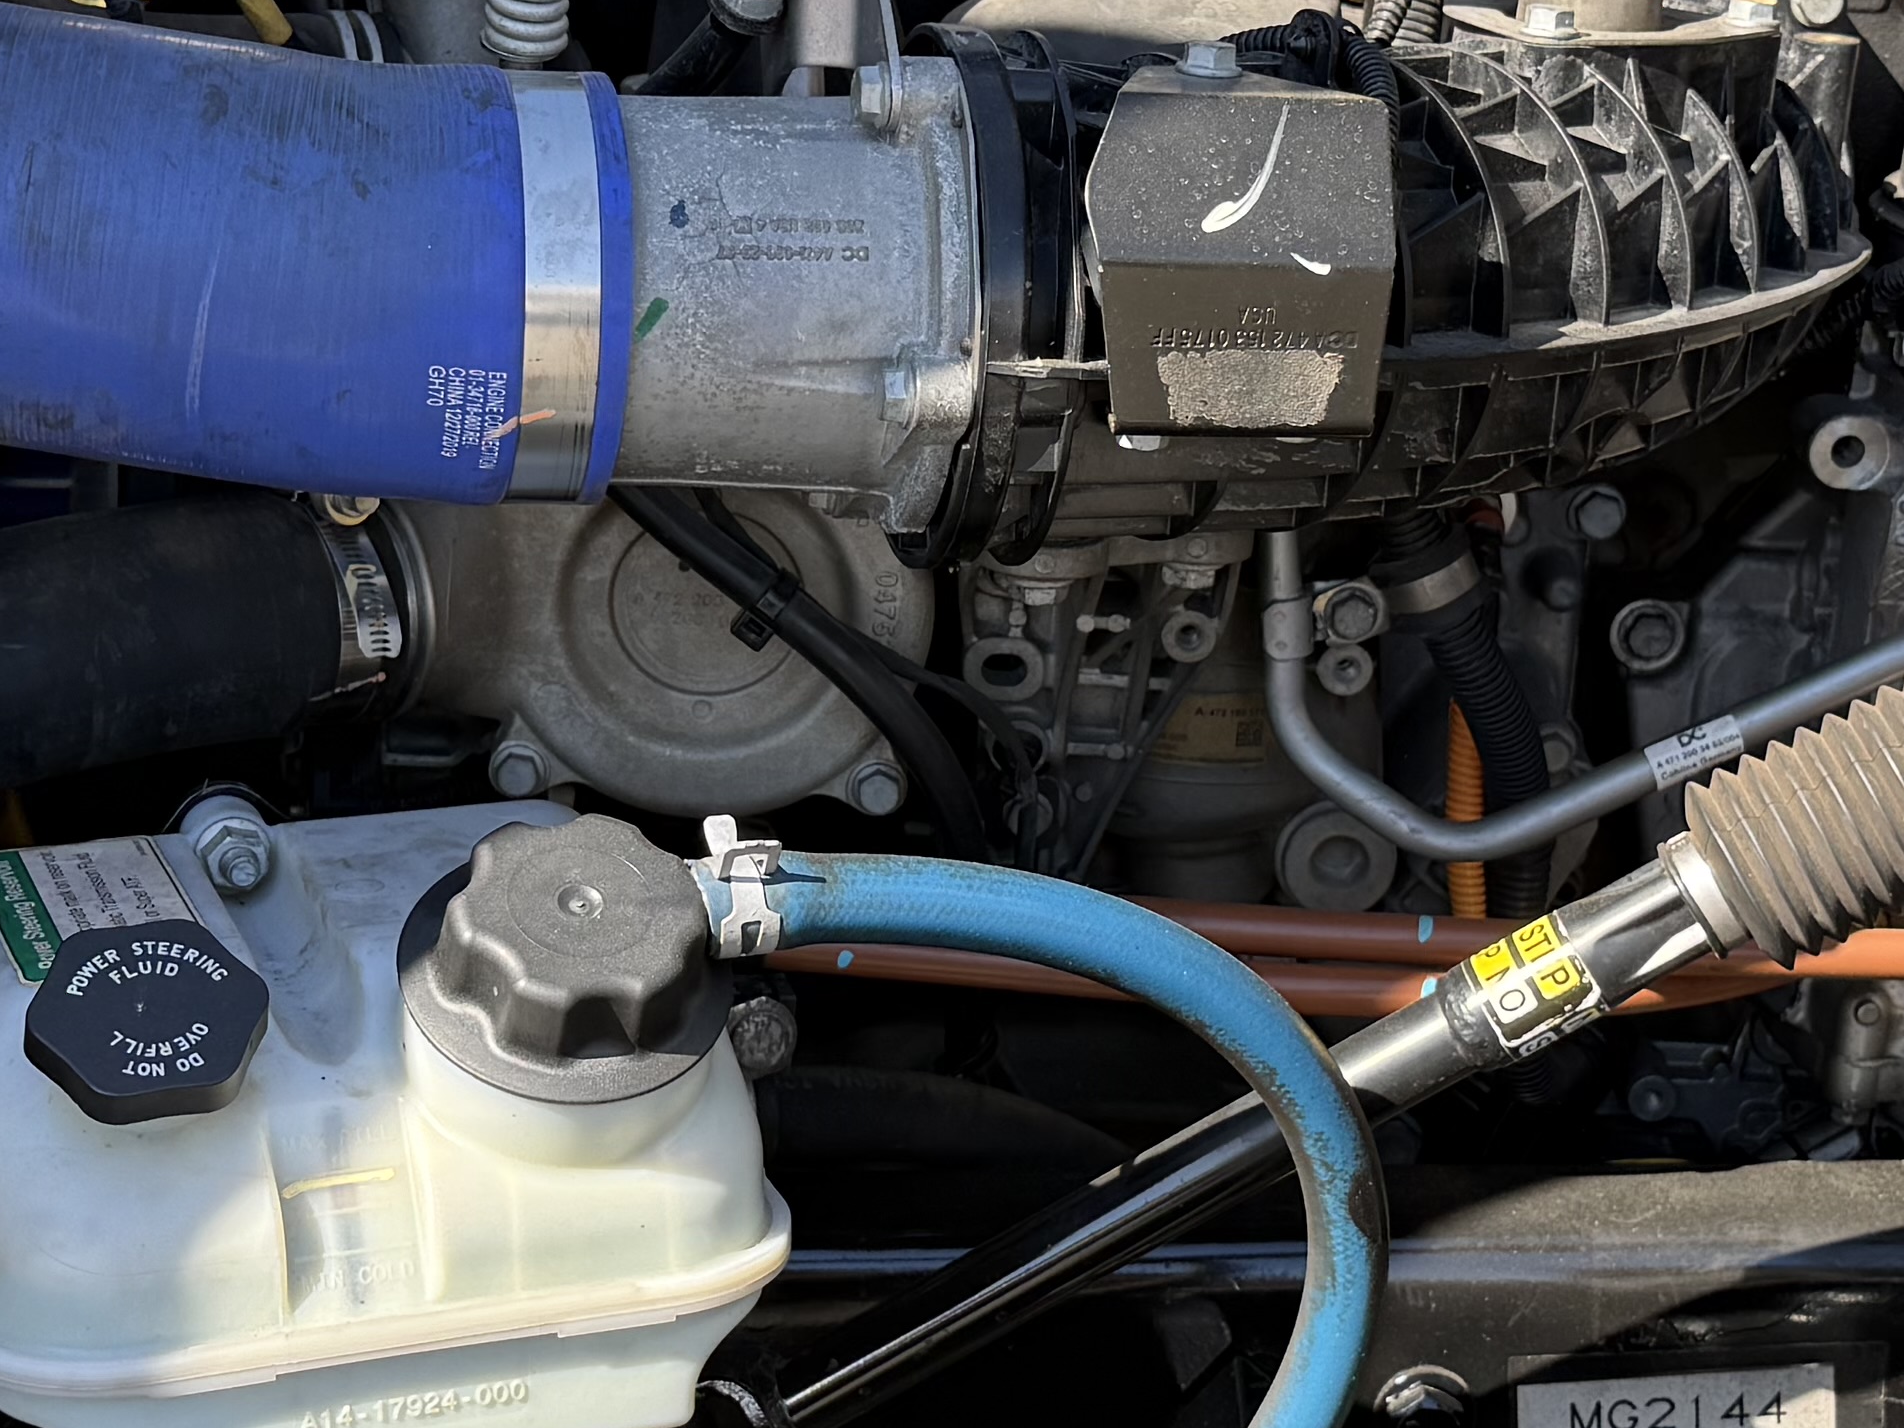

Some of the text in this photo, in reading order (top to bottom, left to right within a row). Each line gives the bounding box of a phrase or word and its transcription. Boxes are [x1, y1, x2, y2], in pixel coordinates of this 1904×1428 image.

[1274, 330, 1310, 348] 472
[427, 366, 446, 406] GH70
[486, 372, 507, 412] ENGINE
[441, 367, 466, 457] CHINA 12/27/2019
[13, 901, 45, 944] Steering
[66, 940, 228, 997] POWER STEERING
[108, 959, 180, 985] FLUID
[109, 1022, 210, 1058] OVERFILL
[122, 1052, 205, 1078] DO NOT
